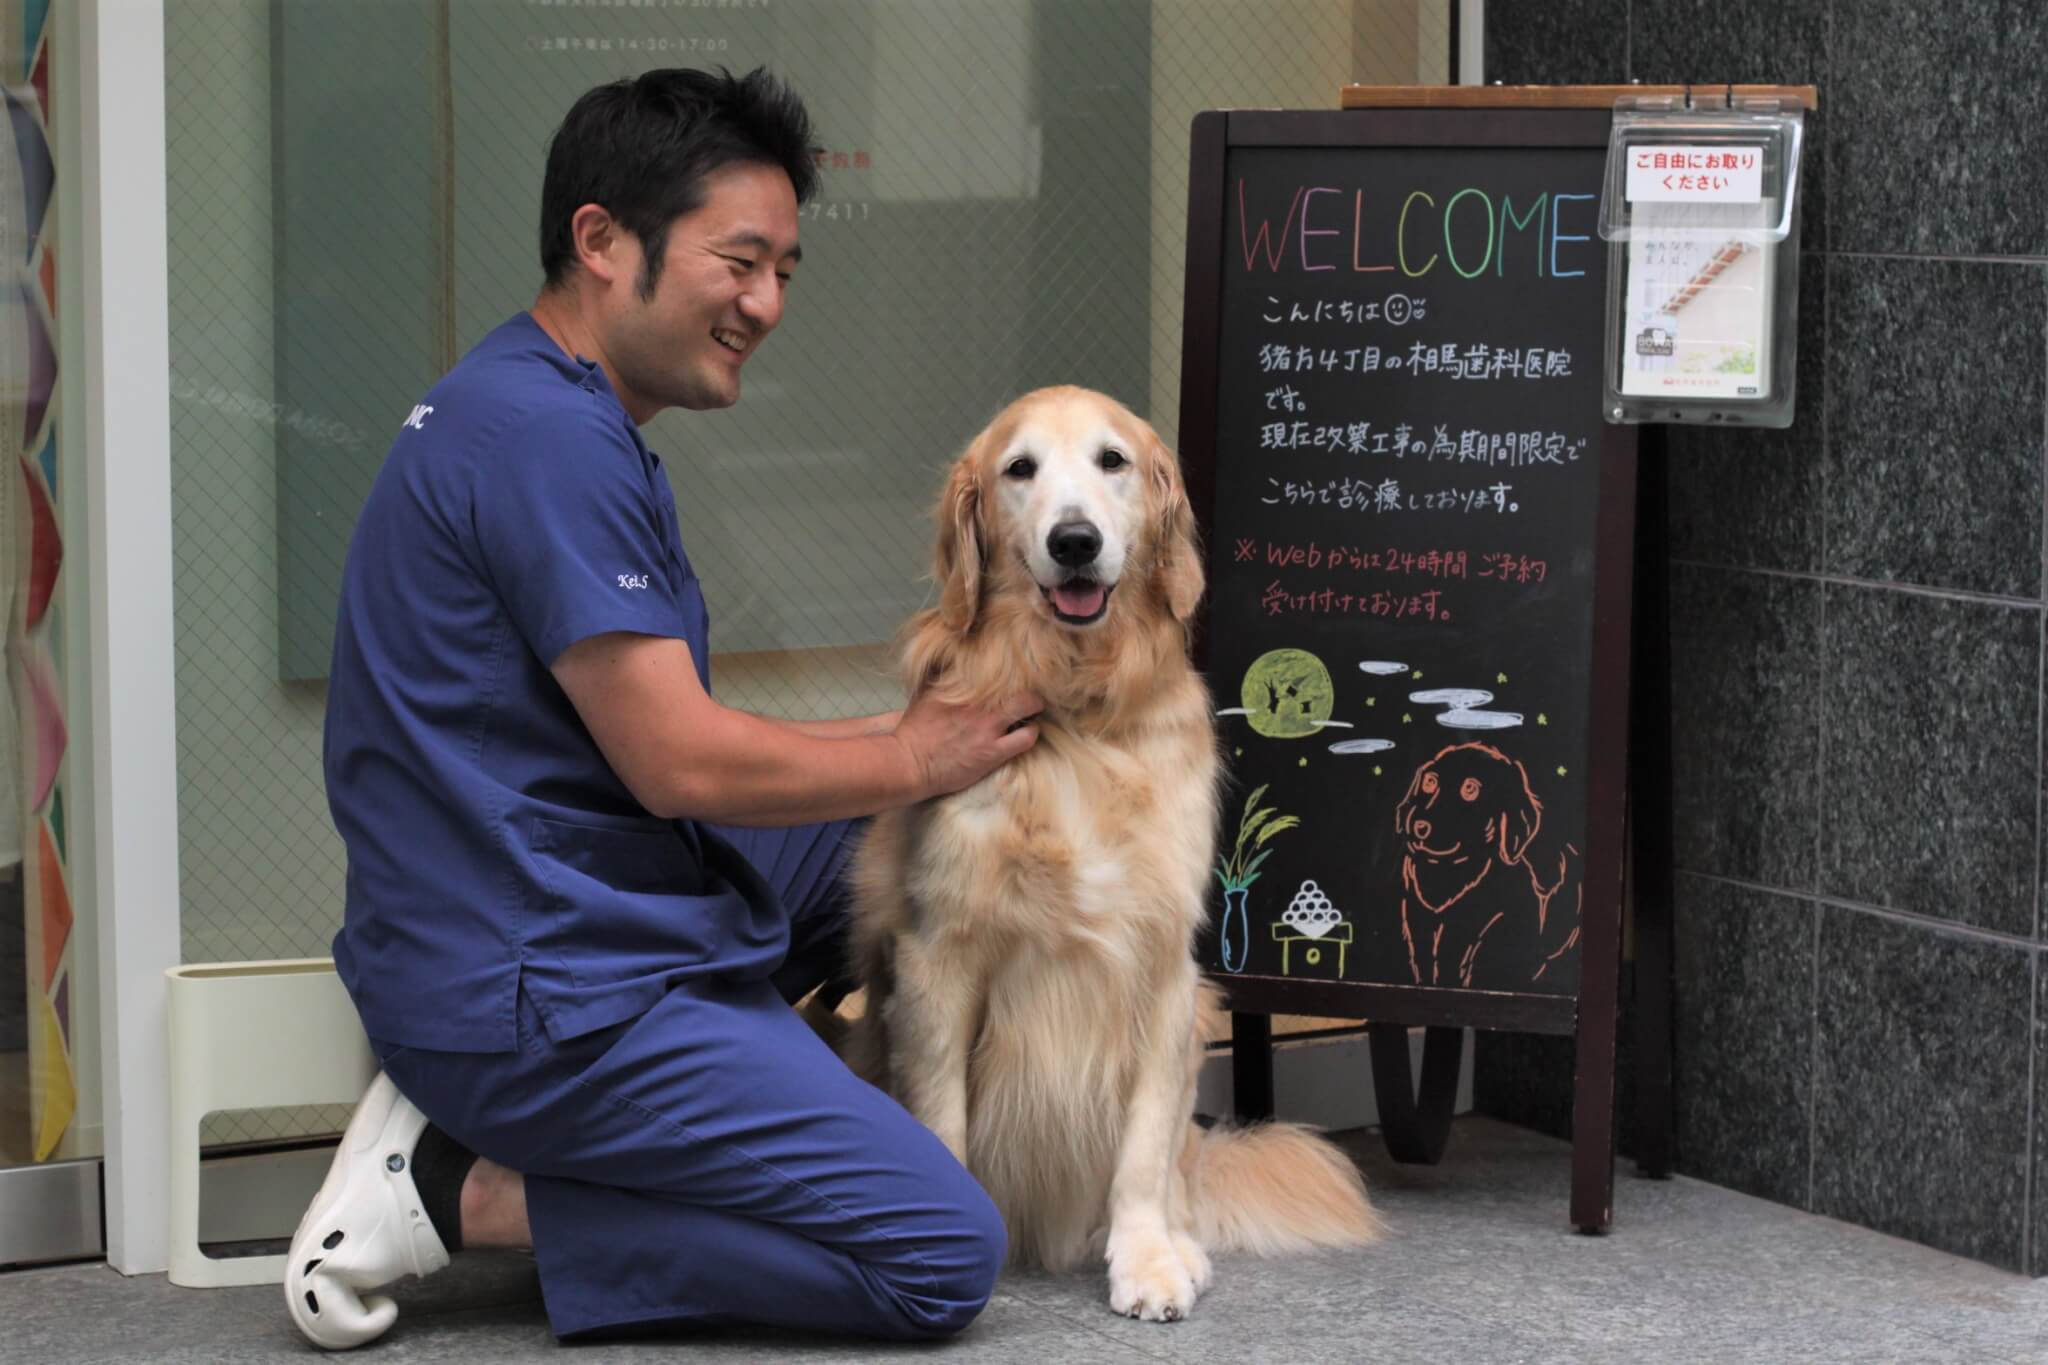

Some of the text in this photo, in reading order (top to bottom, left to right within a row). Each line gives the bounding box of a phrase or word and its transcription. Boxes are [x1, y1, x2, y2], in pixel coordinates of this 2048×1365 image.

[1636, 152, 1755, 170] ご自由にお取り
[1662, 174, 1729, 191] ください
[1239, 177, 1596, 279] WELCOME
[1262, 295, 1381, 323] こんにちは
[1264, 383, 1306, 412] です。
[1259, 420, 1588, 467] 現在改築工事の為期間限定で
[1260, 476, 1520, 514] こちらで診療しております。
[1261, 579, 1451, 622] 受け付けております。
